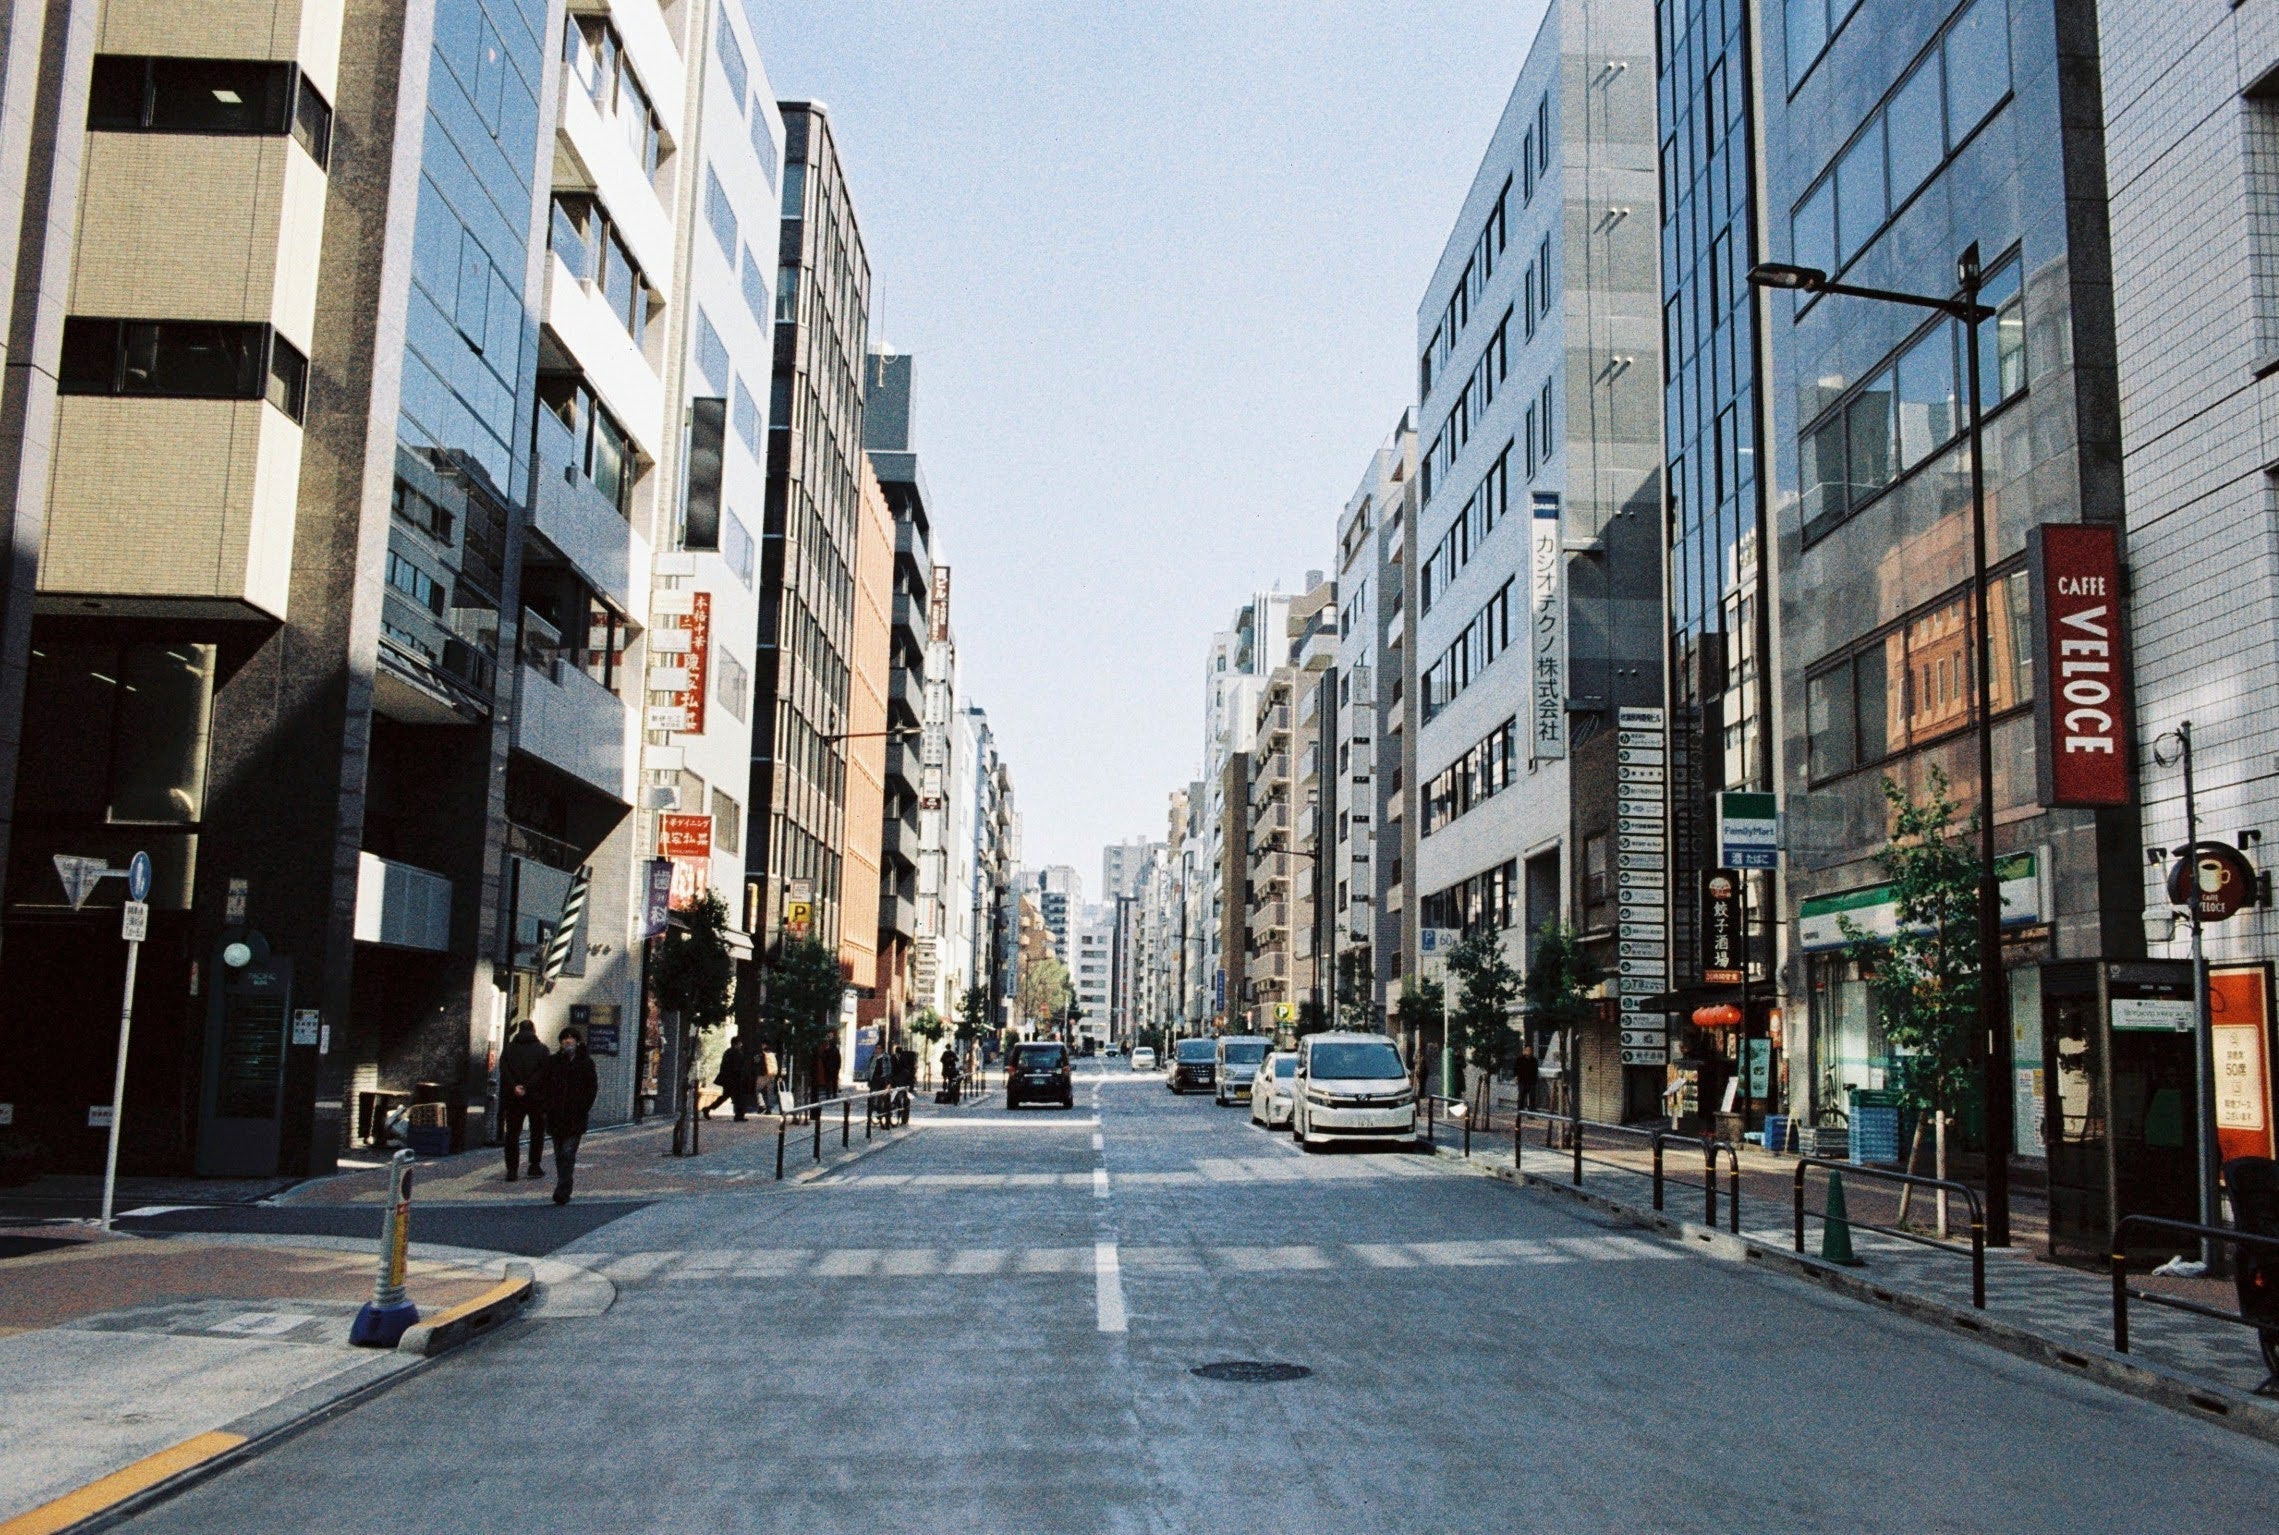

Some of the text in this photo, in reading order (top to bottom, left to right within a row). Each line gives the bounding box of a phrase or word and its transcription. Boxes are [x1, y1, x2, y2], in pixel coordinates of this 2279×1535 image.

[2057, 575, 2106, 597] CAFFE
[1536, 535, 1560, 743] カシオテクノ株式会社
[2060, 604, 2115, 756] VELOCE
[1724, 826, 1775, 838] FamilyMart
[1746, 853, 1770, 865] たばこ
[793, 905, 807, 920] P
[1713, 901, 1730, 968] 餃子酒場
[1279, 1005, 1289, 1018] P
